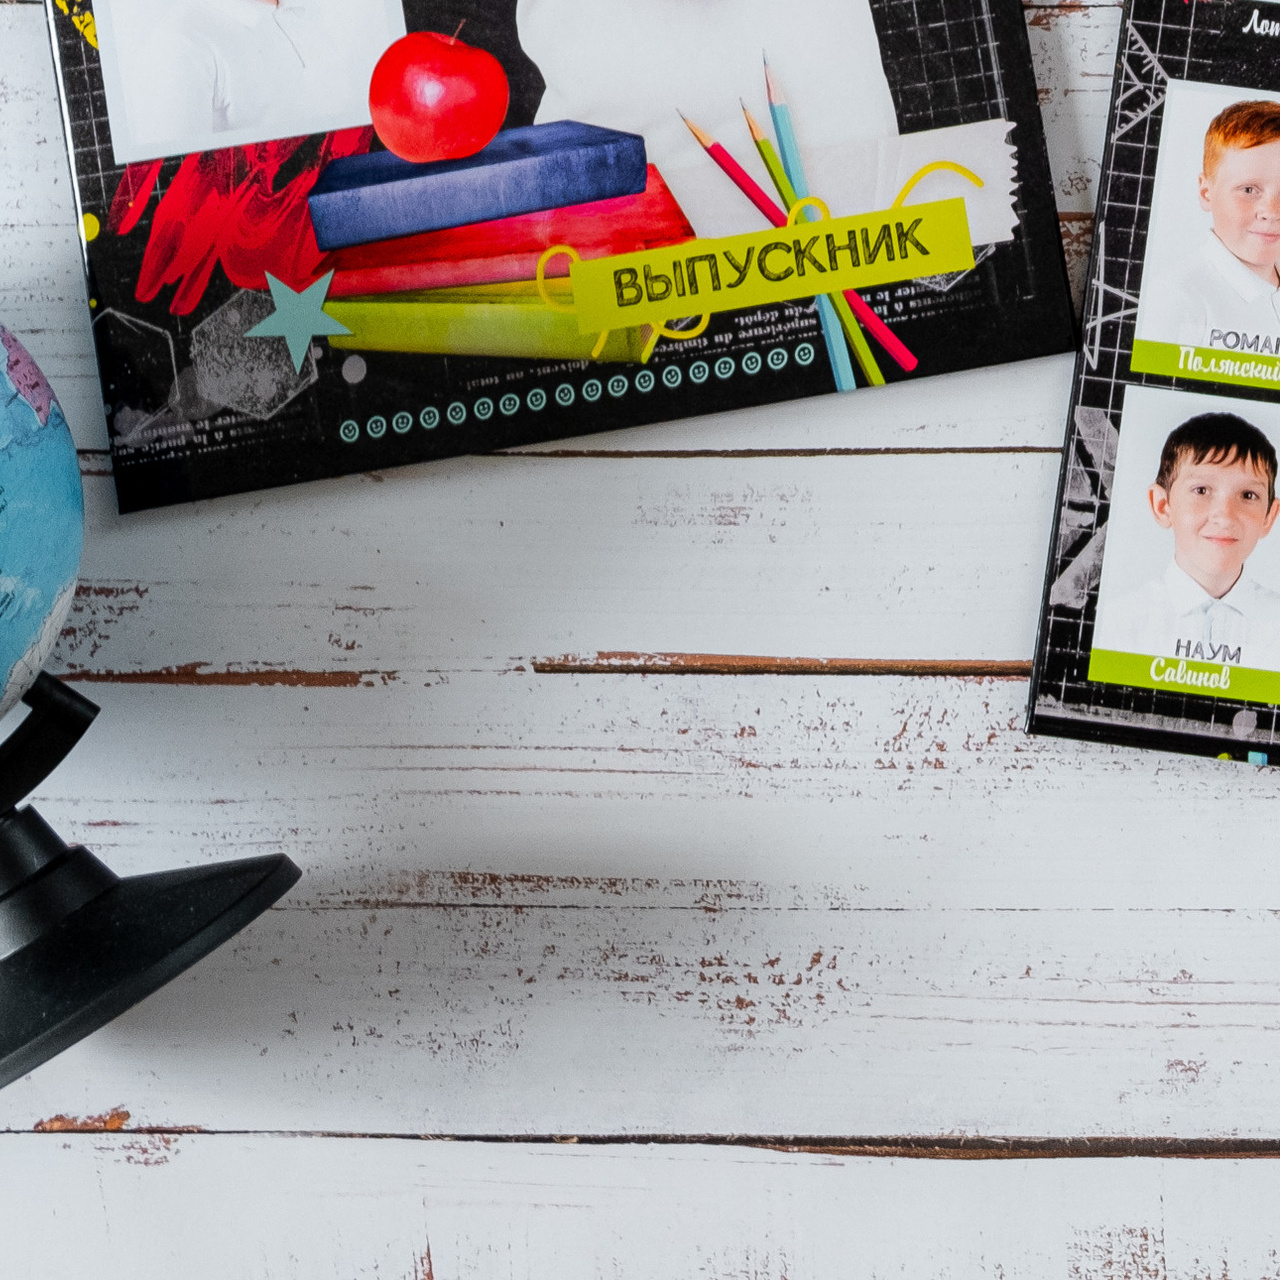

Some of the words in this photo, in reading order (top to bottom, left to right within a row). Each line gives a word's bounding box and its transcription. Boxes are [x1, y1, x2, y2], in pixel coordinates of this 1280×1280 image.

[613, 218, 931, 308] ВЫПУСКНИК
[1175, 638, 1242, 664] НАУМ
[1149, 657, 1231, 690] Савинов
